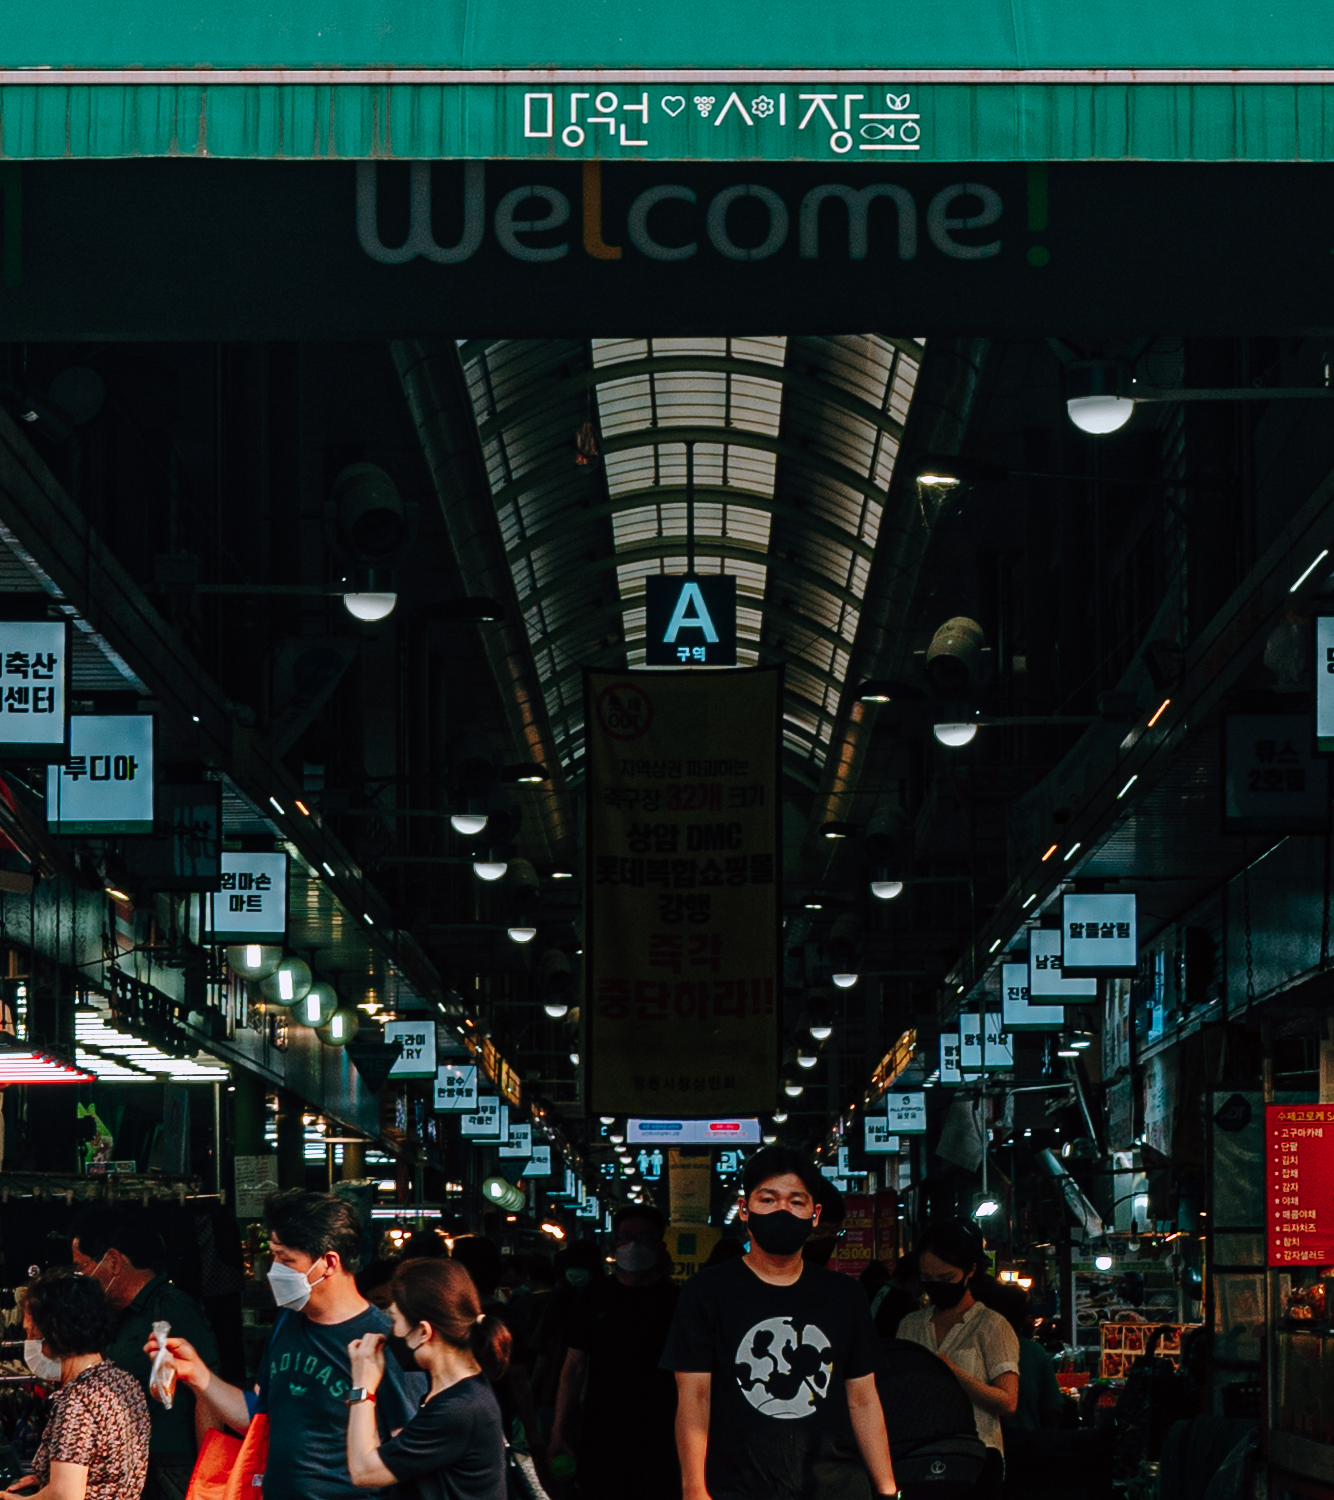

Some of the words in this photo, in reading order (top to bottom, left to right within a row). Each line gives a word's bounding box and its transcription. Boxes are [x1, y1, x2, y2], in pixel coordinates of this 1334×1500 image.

[663, 581, 720, 643] A
[676, 646, 707, 663] 구역
[219, 871, 272, 893] 엄마손
[228, 894, 263, 913] 마트
[1069, 922, 1130, 939] 알뜰살림
[269, 1351, 350, 1398] ADIDAS
